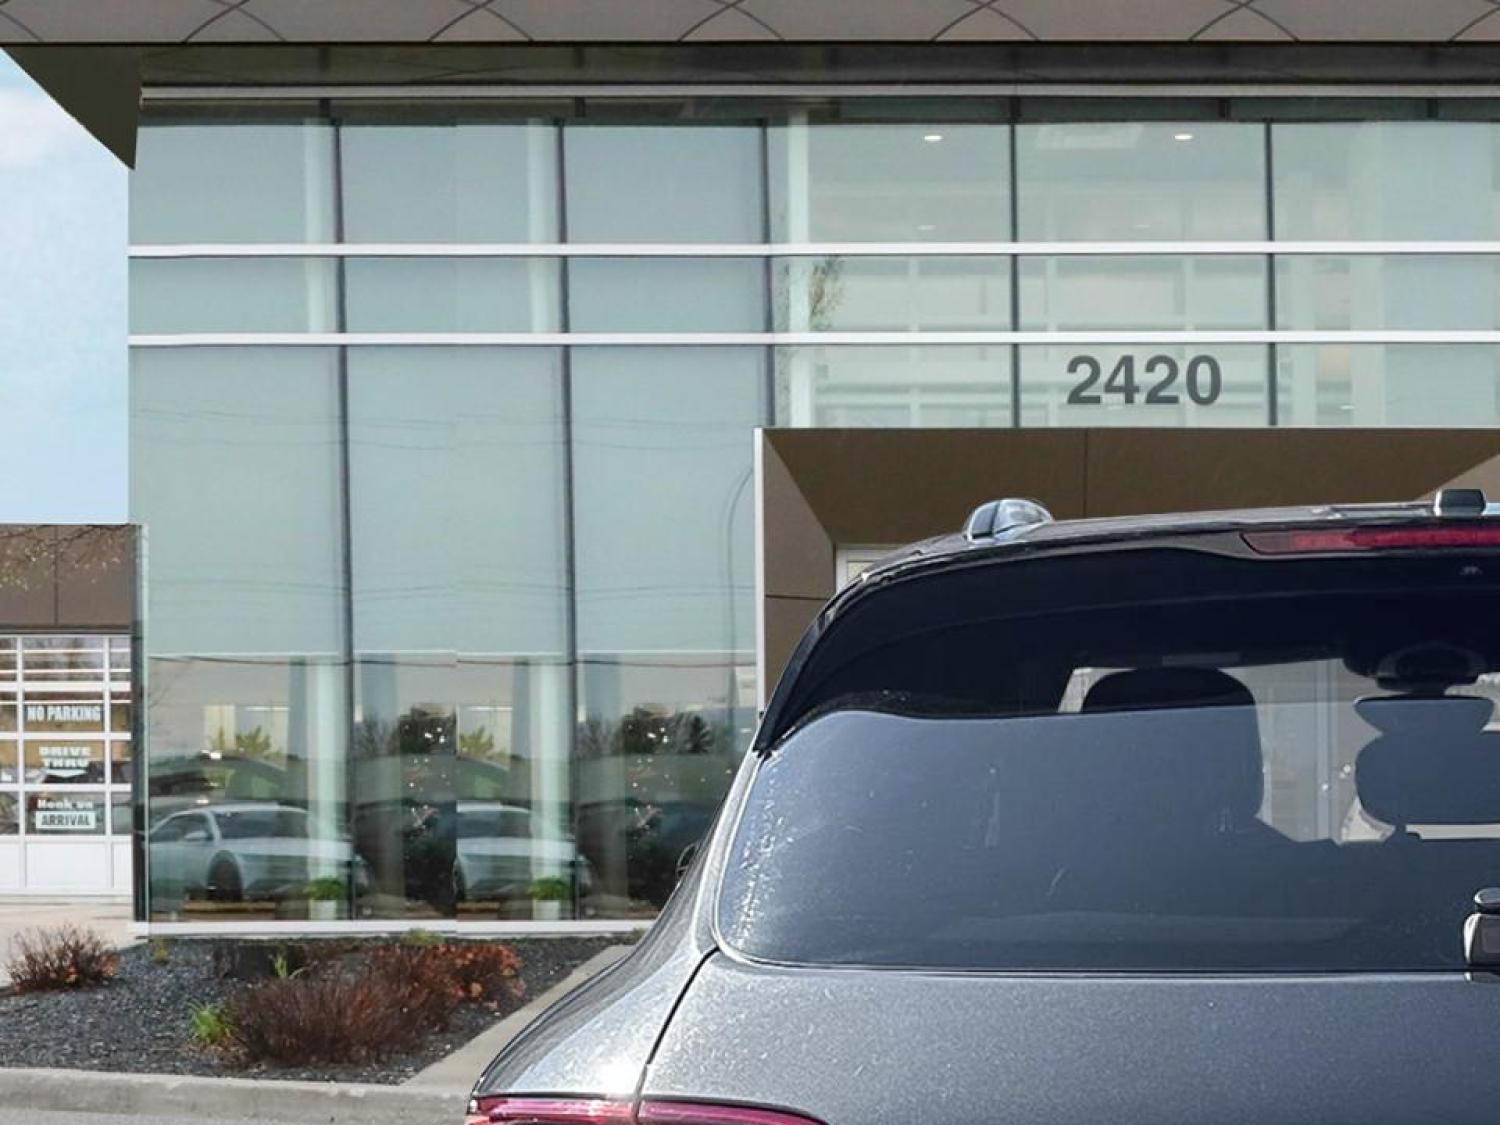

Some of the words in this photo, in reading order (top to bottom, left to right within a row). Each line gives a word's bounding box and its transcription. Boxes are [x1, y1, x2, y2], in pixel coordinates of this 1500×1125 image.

[1066, 354, 1222, 406] 2420
[27, 705, 44, 721] NO
[47, 705, 101, 721] PARKING
[41, 814, 91, 826] ARRIVAL
